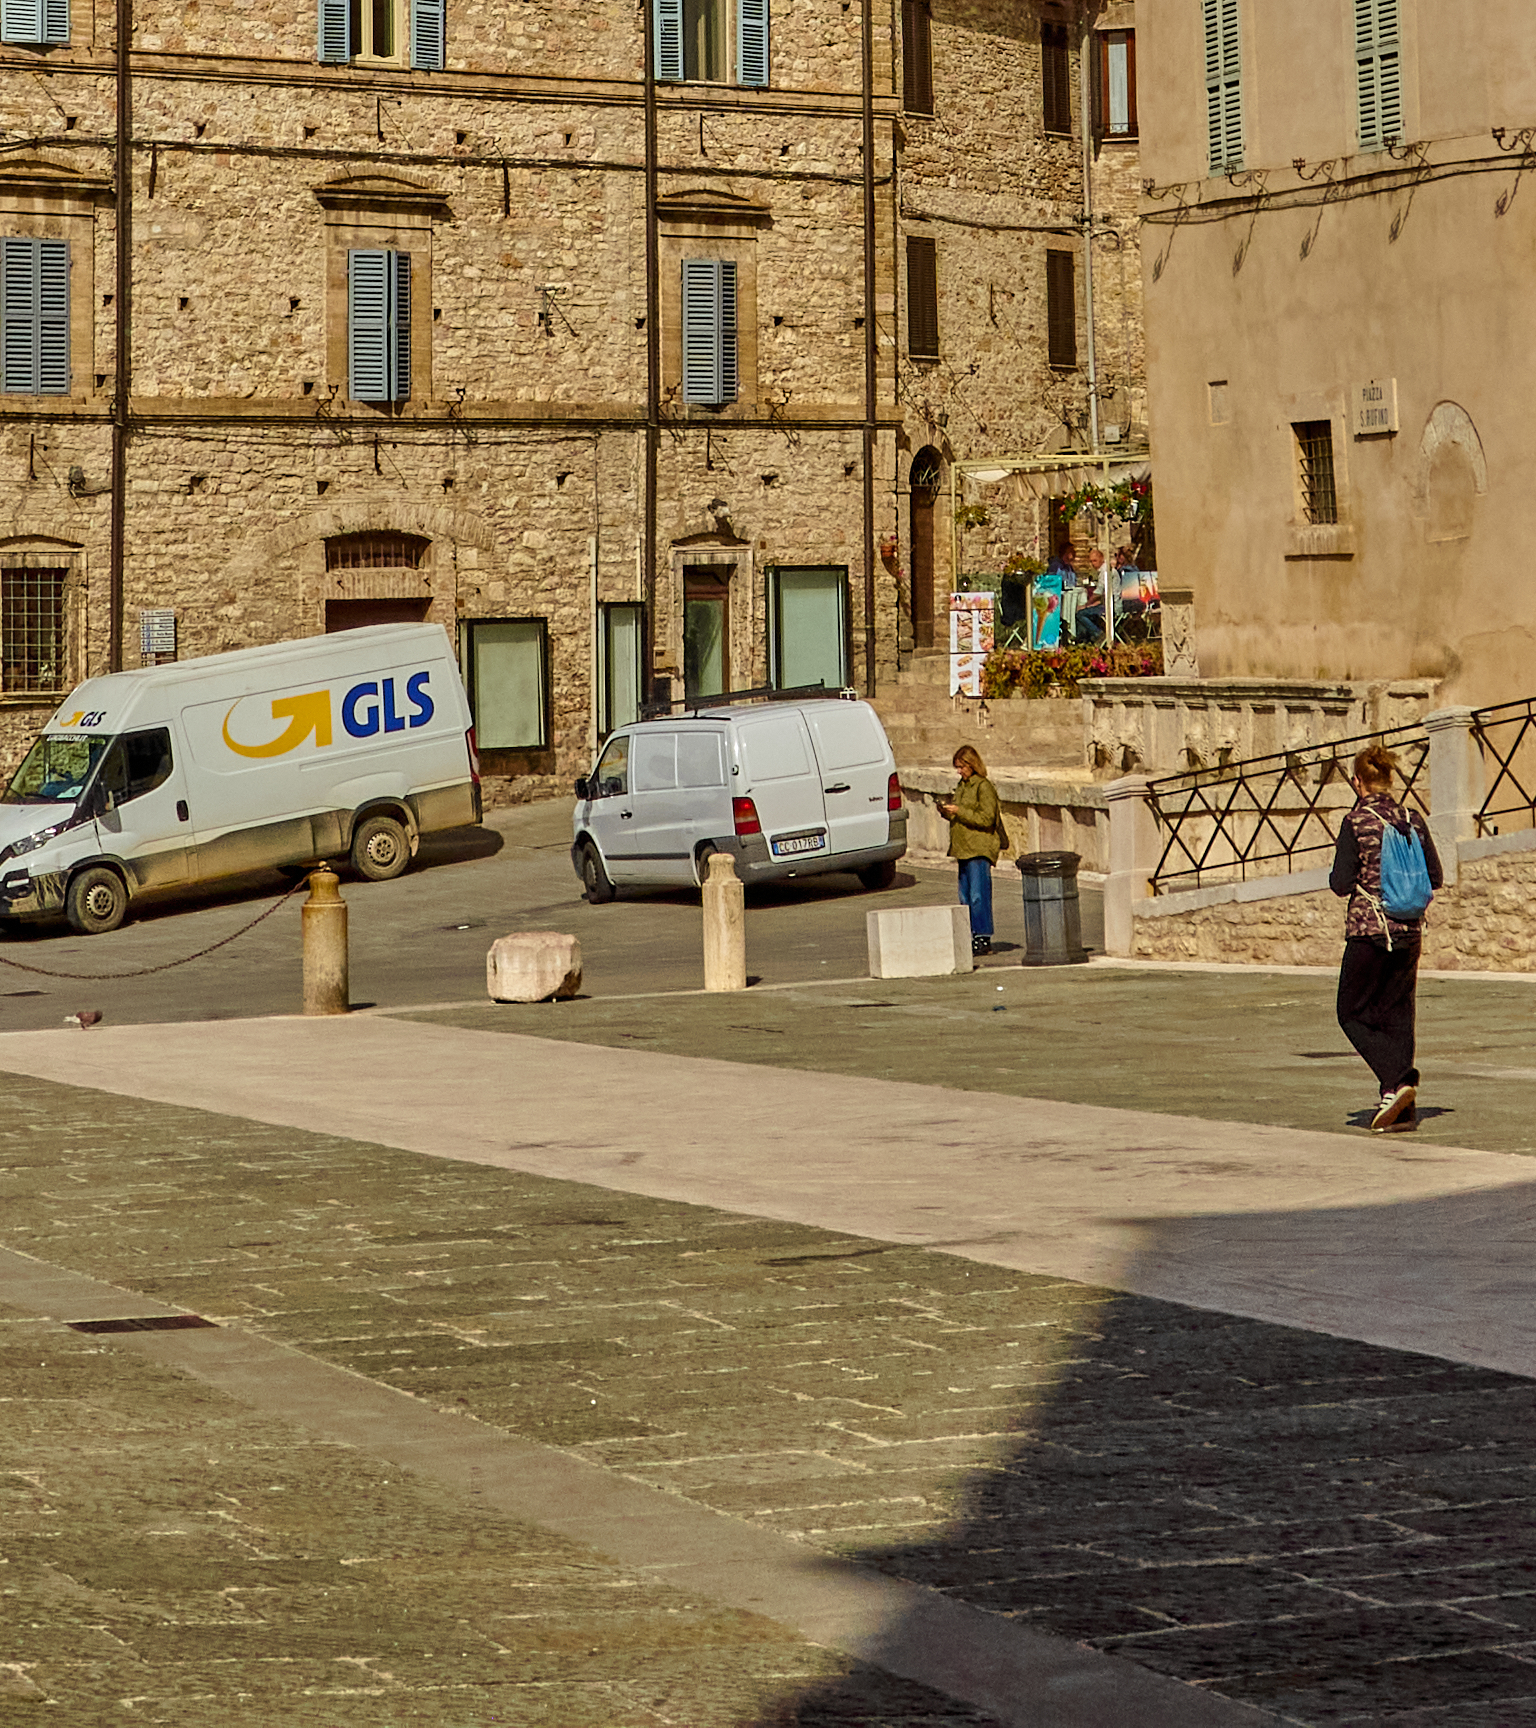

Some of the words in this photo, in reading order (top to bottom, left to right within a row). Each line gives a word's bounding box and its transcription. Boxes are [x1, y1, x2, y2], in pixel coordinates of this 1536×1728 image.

[1362, 386, 1383, 401] PIAZZA
[342, 671, 434, 738] GLS
[80, 711, 107, 727] GLS
